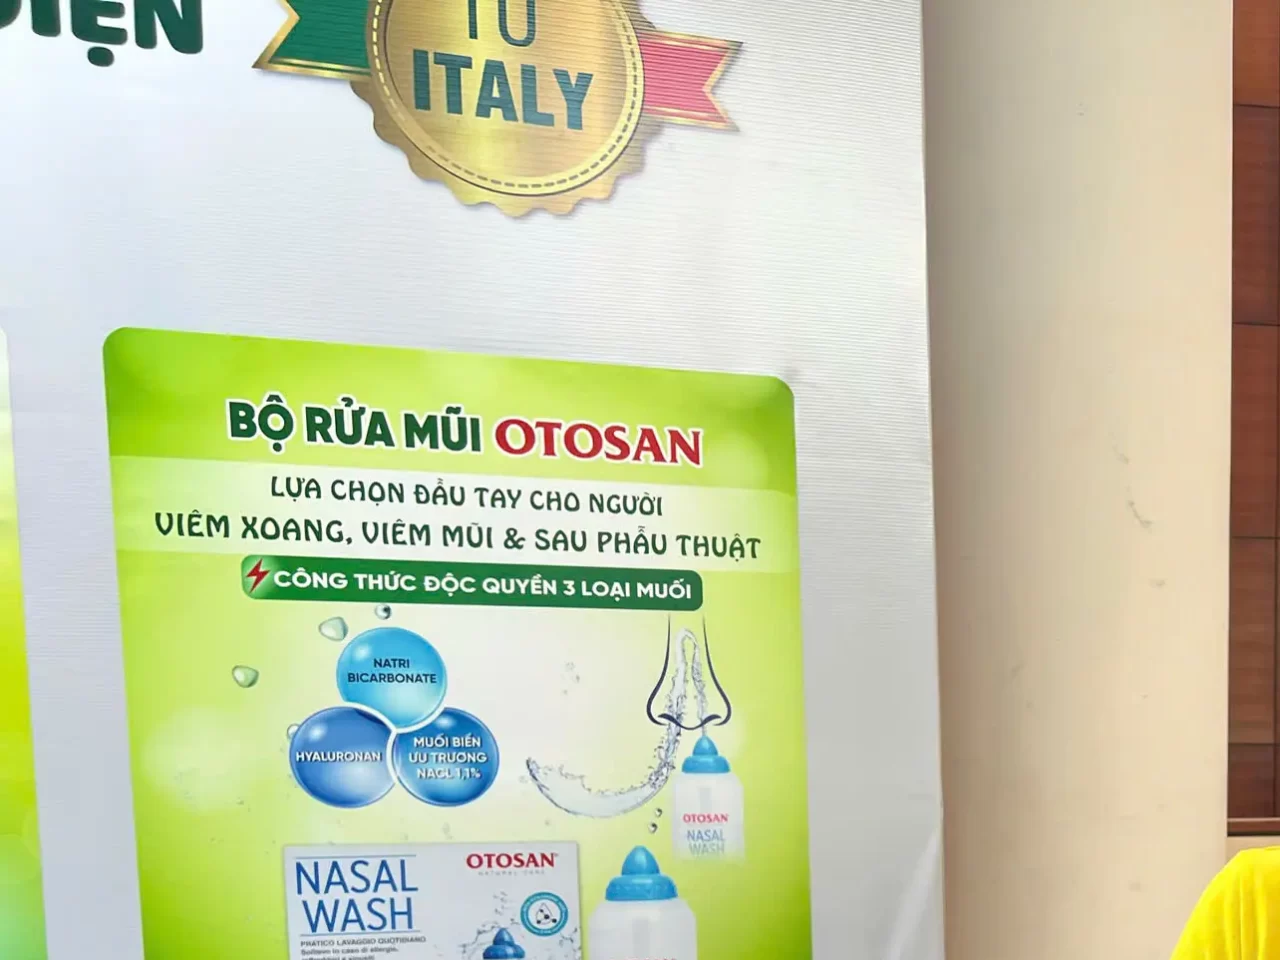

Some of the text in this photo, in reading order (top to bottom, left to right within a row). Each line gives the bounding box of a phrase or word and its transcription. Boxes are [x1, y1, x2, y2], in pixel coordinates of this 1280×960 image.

[413, 49, 593, 130] ITALY
[229, 394, 701, 466] BỘ RỬA MŨI OTOSAN
[271, 476, 322, 502] LỰA
[330, 479, 404, 506] CHỌN
[474, 487, 522, 509] TAY
[530, 490, 580, 512] CHO
[589, 492, 663, 516] NGƯỜI
[155, 510, 762, 562] VIÊM XOANG, VIÊM MŨI & SAU PHẪU THUẬT
[273, 567, 692, 602] CÔNG THỨC ĐỘC QUYỀN 3 LOẠI MUỐI
[347, 672, 437, 684] BICARBONATE
[373, 658, 410, 669] NATRI
[296, 751, 382, 762] HYALURONAN
[683, 813, 728, 823] OTOSAN
[687, 829, 725, 842] NASAL
[295, 858, 418, 895] NASAL
[466, 853, 555, 869] OTOSAN
[302, 897, 414, 933] WASH
